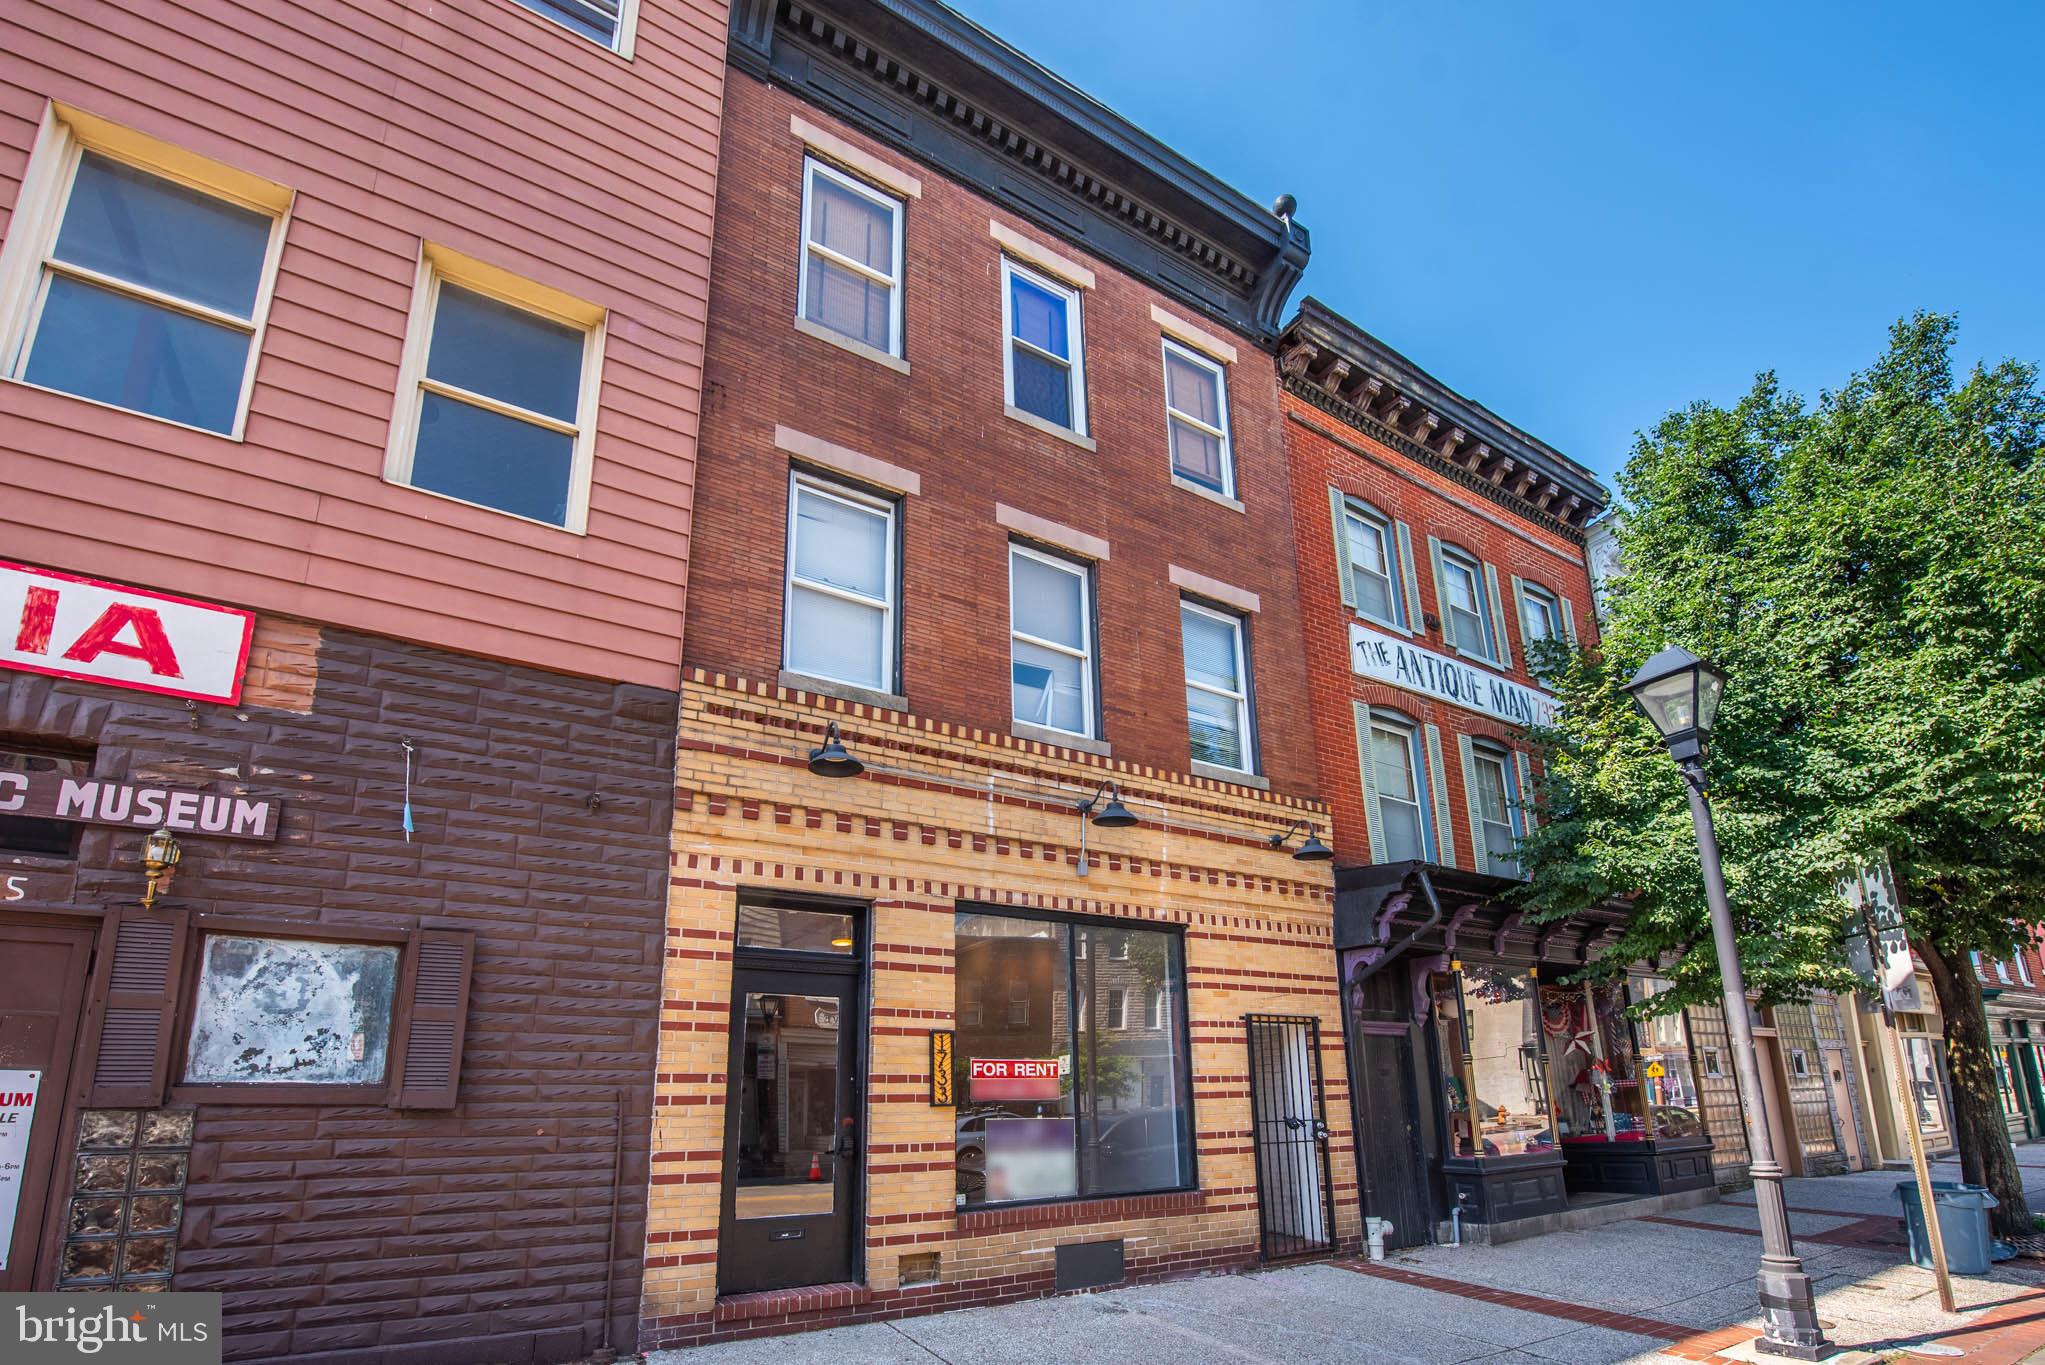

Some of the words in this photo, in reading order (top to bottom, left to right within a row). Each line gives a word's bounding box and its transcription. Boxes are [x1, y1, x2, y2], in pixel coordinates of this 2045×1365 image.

[15, 585, 184, 680] IA
[1356, 640, 1391, 667] THE
[1396, 645, 1484, 707] ANTIQUE
[1489, 678, 1532, 724] MAN
[0, 771, 29, 811] C
[55, 779, 270, 836] MUSEUM
[936, 1034, 949, 1104] 1733
[973, 1062, 1007, 1077] FOR
[1014, 1062, 1057, 1077] RENT
